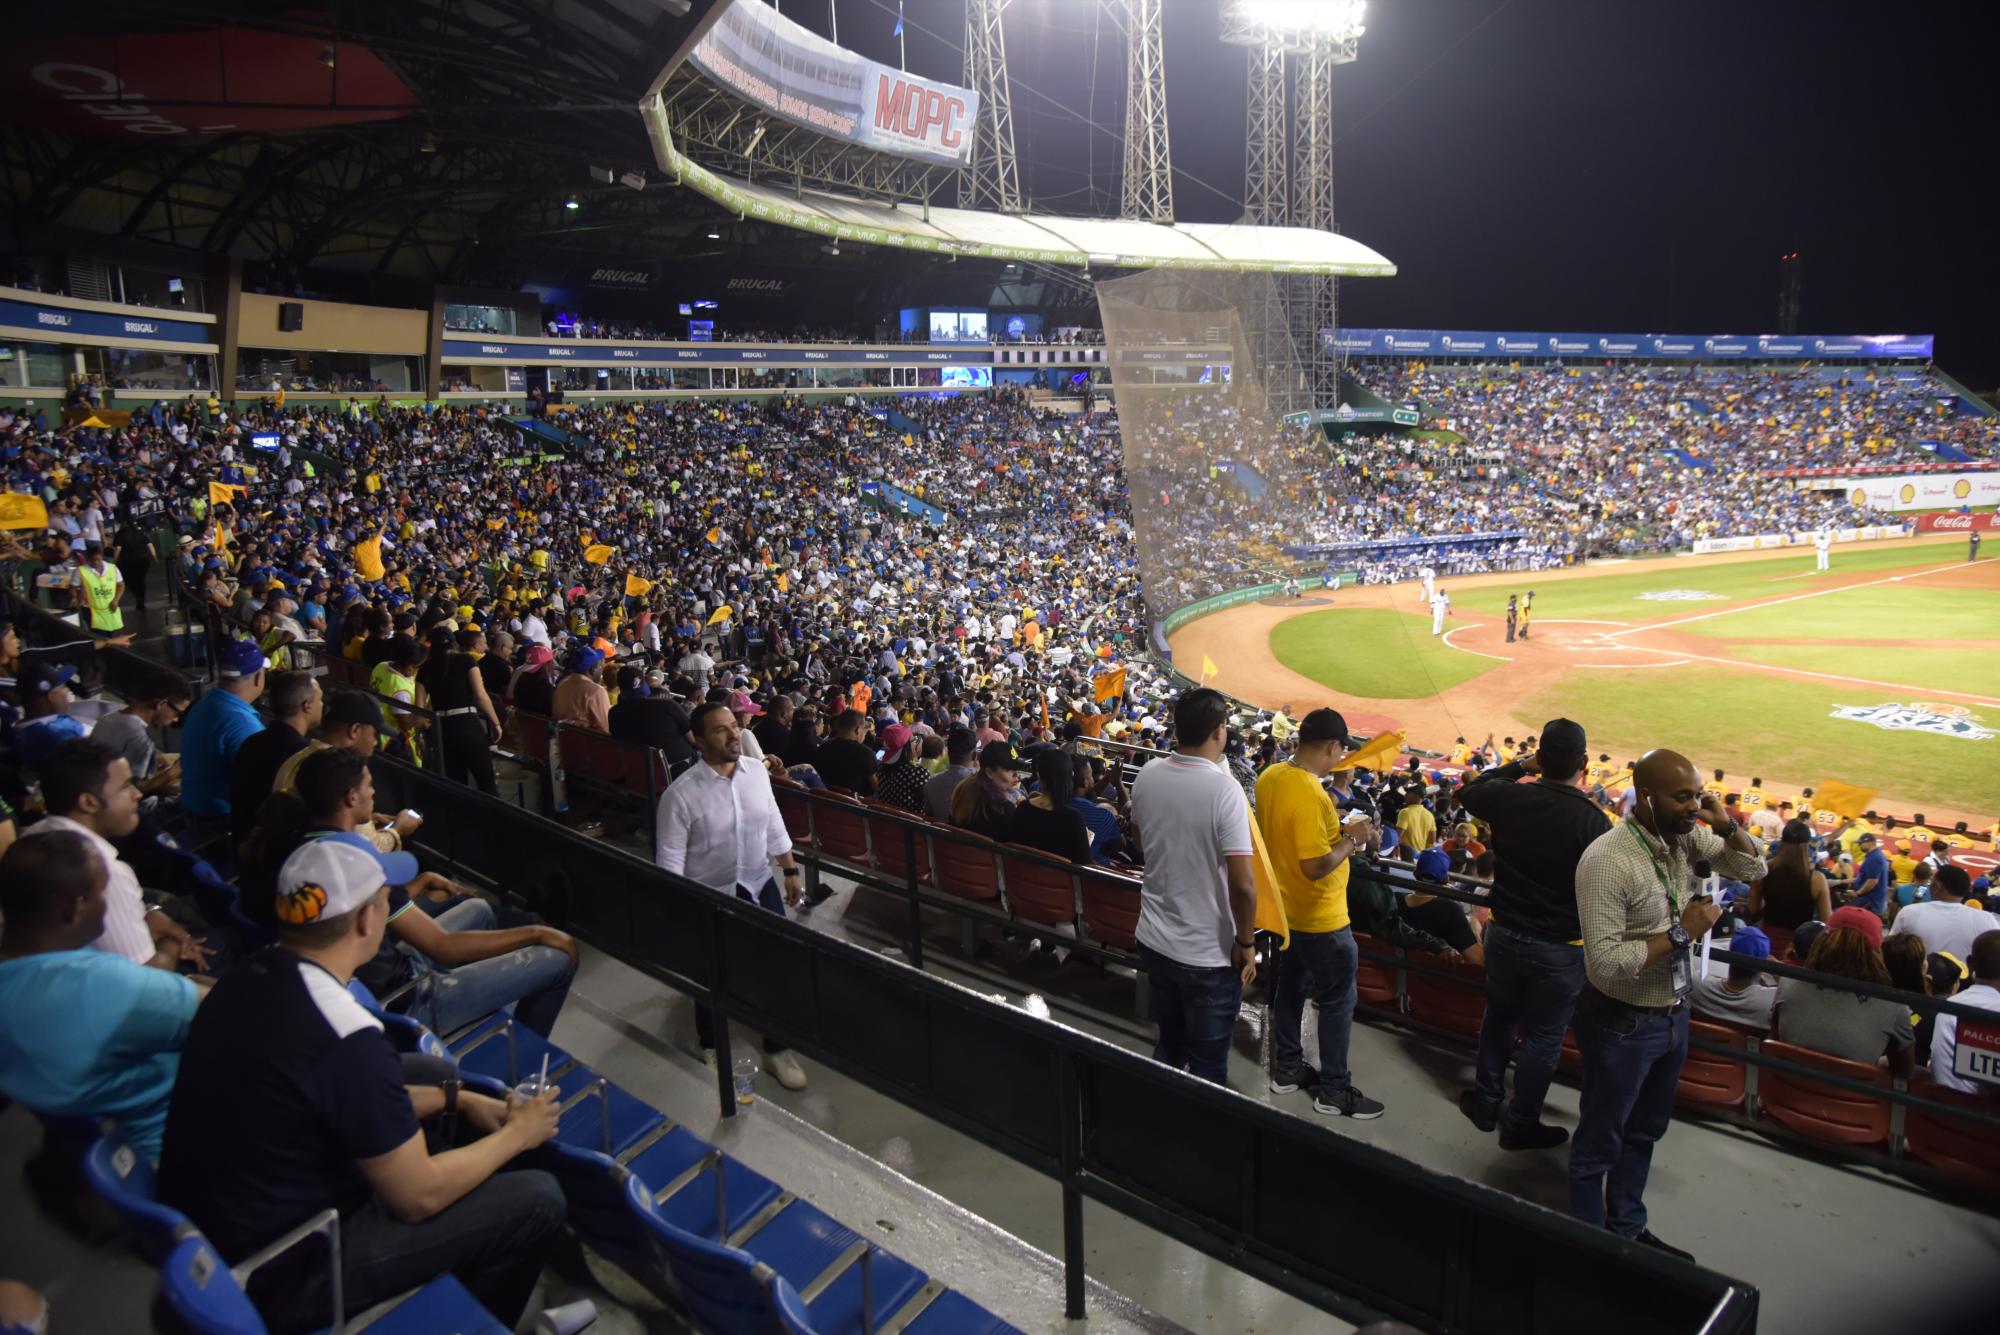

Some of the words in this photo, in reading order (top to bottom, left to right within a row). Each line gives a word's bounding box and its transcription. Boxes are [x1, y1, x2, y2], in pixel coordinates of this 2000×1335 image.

[31, 62, 188, 134] Claro
[874, 74, 965, 148] MOPC
[592, 269, 649, 284] BRUGAL
[727, 278, 783, 290] BRUGAL
[38, 312, 68, 326] BRUGAL
[125, 321, 154, 334] BRUGAL
[482, 345, 504, 354] BRUGAL
[549, 348, 571, 356] BRUGAL
[614, 350, 634, 358] BRUGAL
[1933, 515, 1974, 528] Coca-Cola
[1743, 793, 1760, 805] 82
